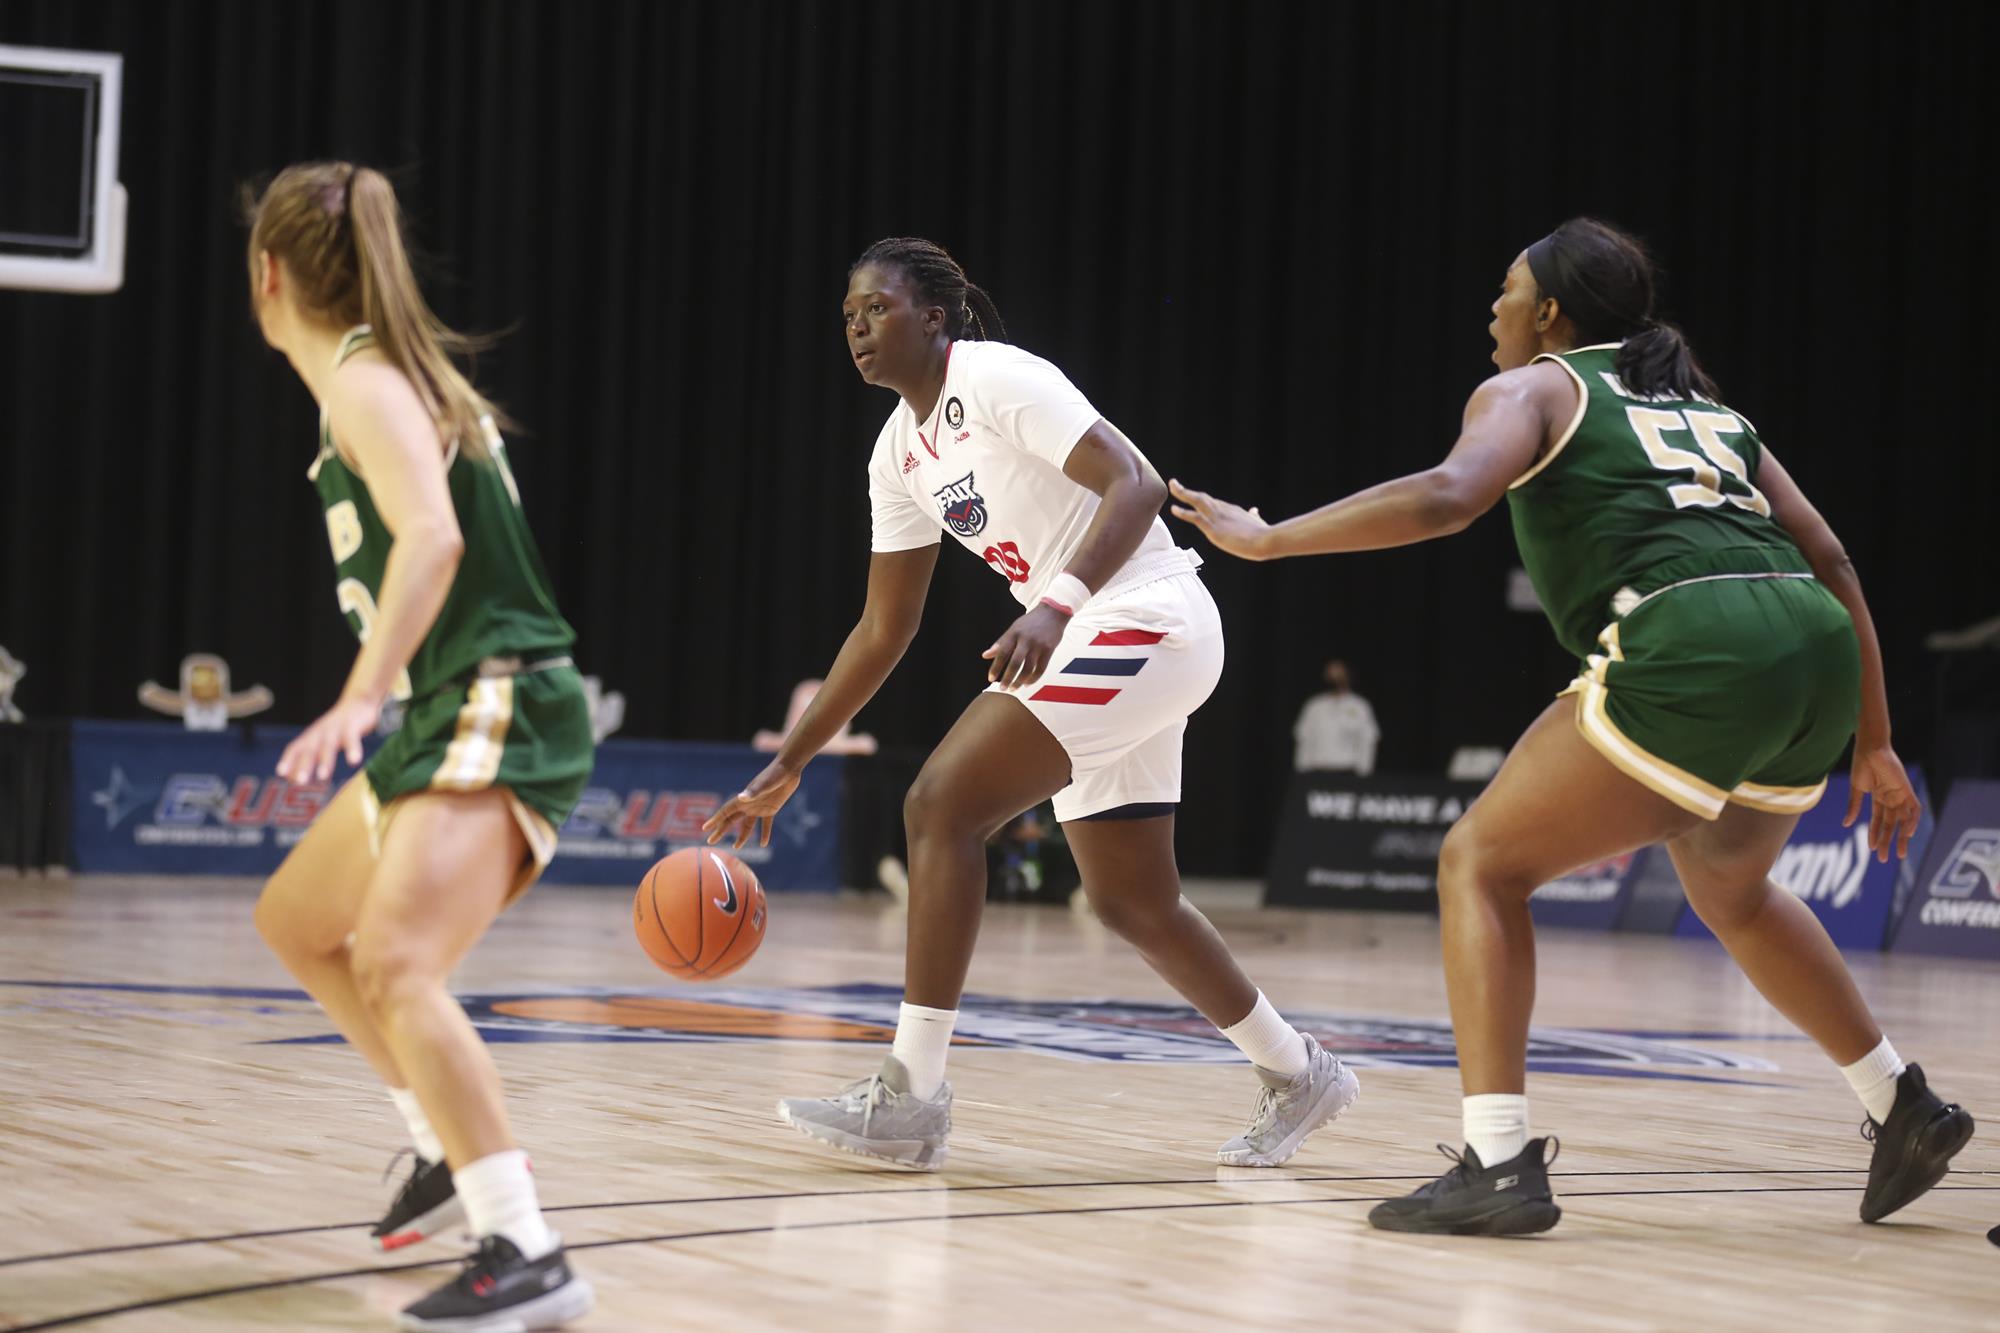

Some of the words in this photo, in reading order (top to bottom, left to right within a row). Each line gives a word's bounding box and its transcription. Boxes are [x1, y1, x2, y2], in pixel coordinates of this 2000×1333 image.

[1625, 405, 1771, 519] 55
[936, 485, 977, 513] FAU
[1306, 790, 1356, 822] WE
[1357, 794, 1438, 826] HAVE
